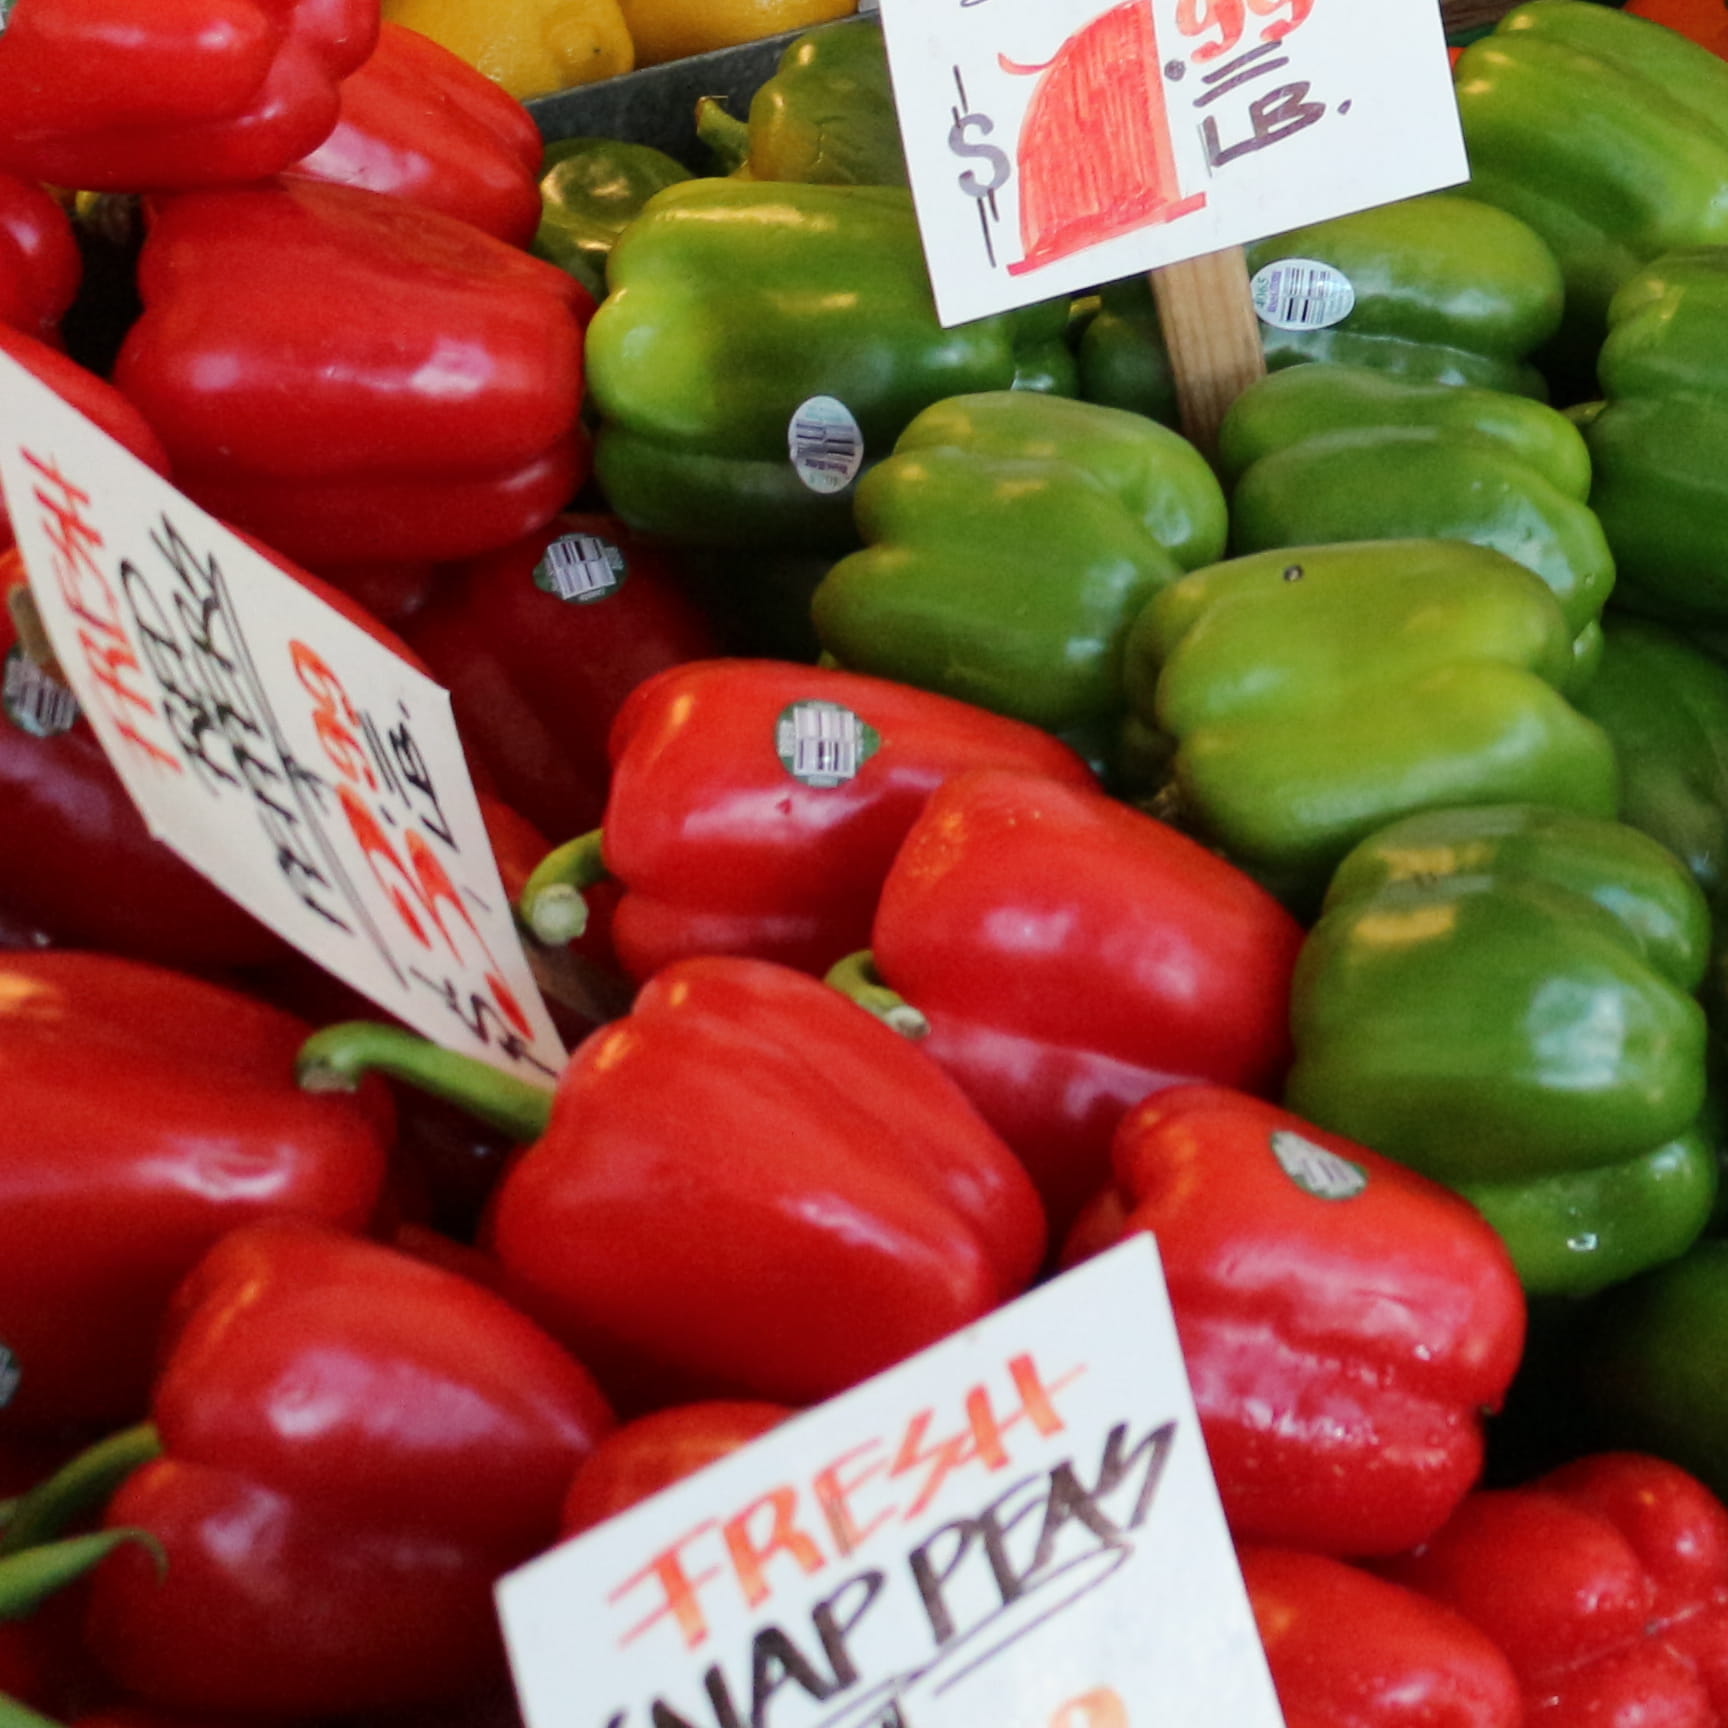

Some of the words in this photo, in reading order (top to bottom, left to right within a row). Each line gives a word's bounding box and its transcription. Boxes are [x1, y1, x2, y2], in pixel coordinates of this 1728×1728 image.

[1199, 79, 1354, 169] LB.
[18, 443, 188, 775] FRESH
[118, 555, 245, 792] RED
[607, 1351, 1090, 1650] FRESH
[906, 1417, 1181, 1645] PEAS
